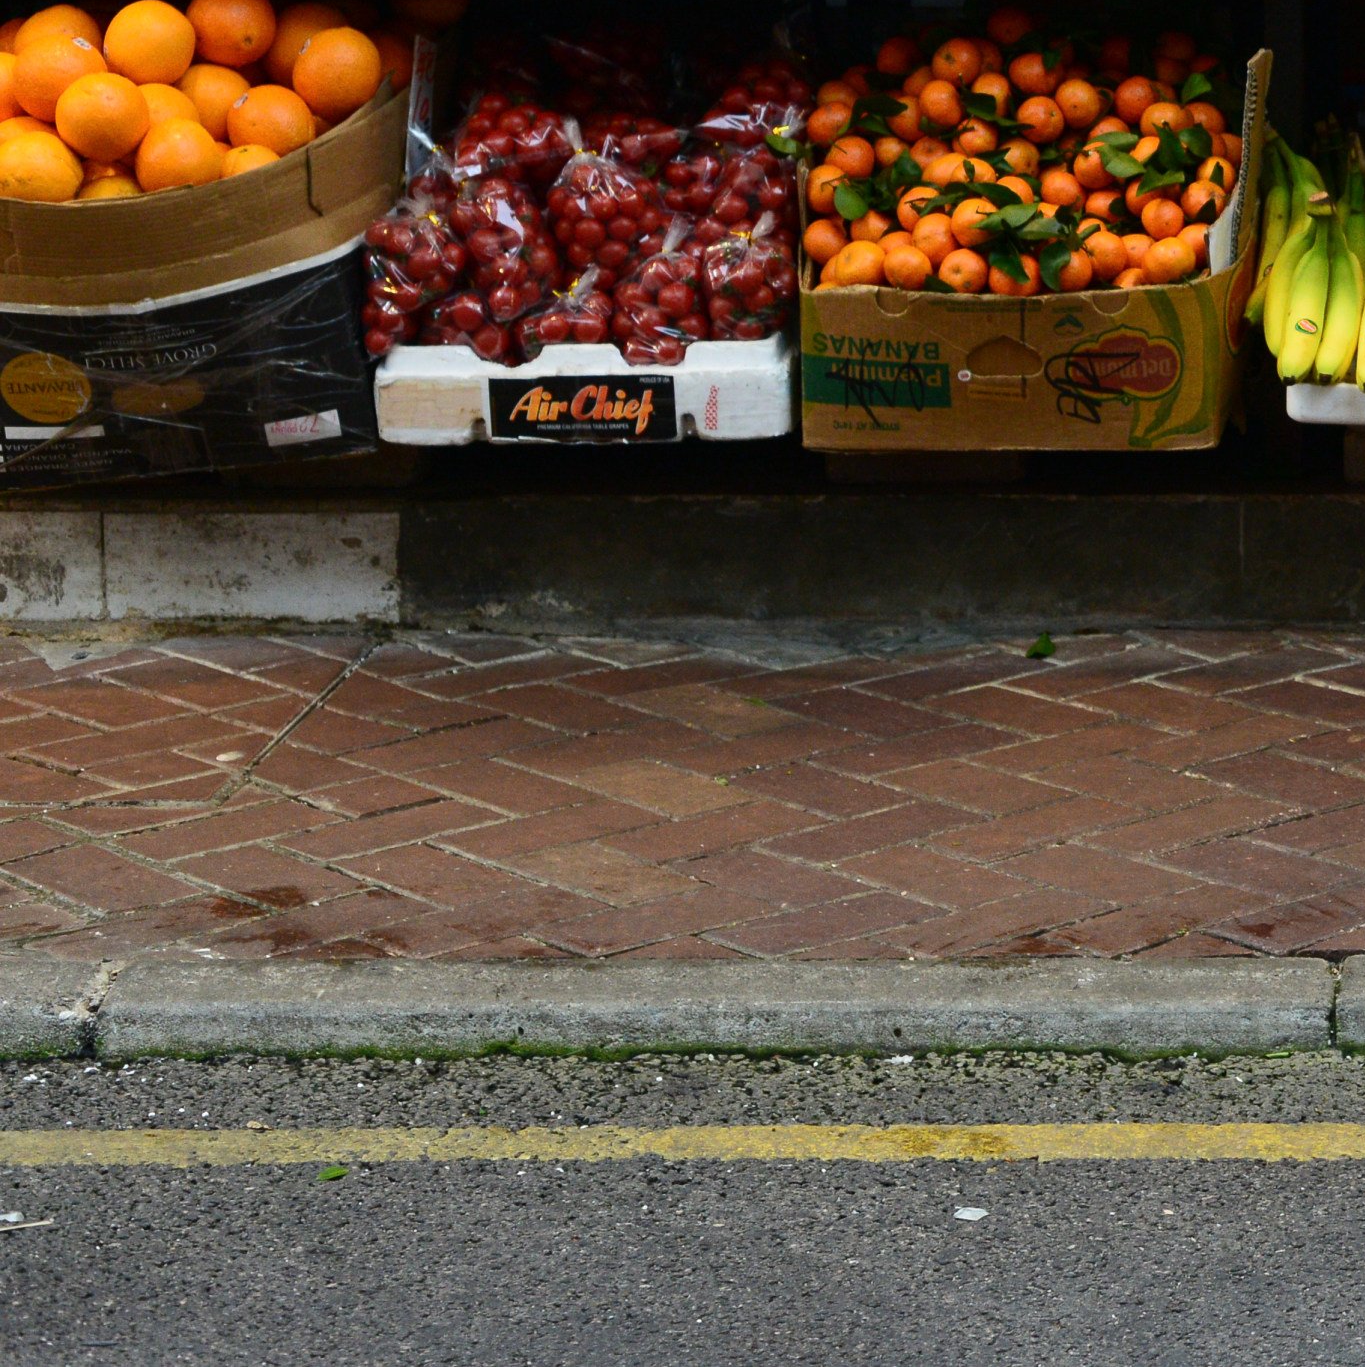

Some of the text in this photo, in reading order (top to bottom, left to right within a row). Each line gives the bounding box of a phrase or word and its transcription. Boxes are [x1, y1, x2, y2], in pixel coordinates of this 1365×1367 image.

[158, 341, 219, 366] GROVE
[812, 331, 941, 361] BANANAS
[509, 383, 655, 436] Air Chief
